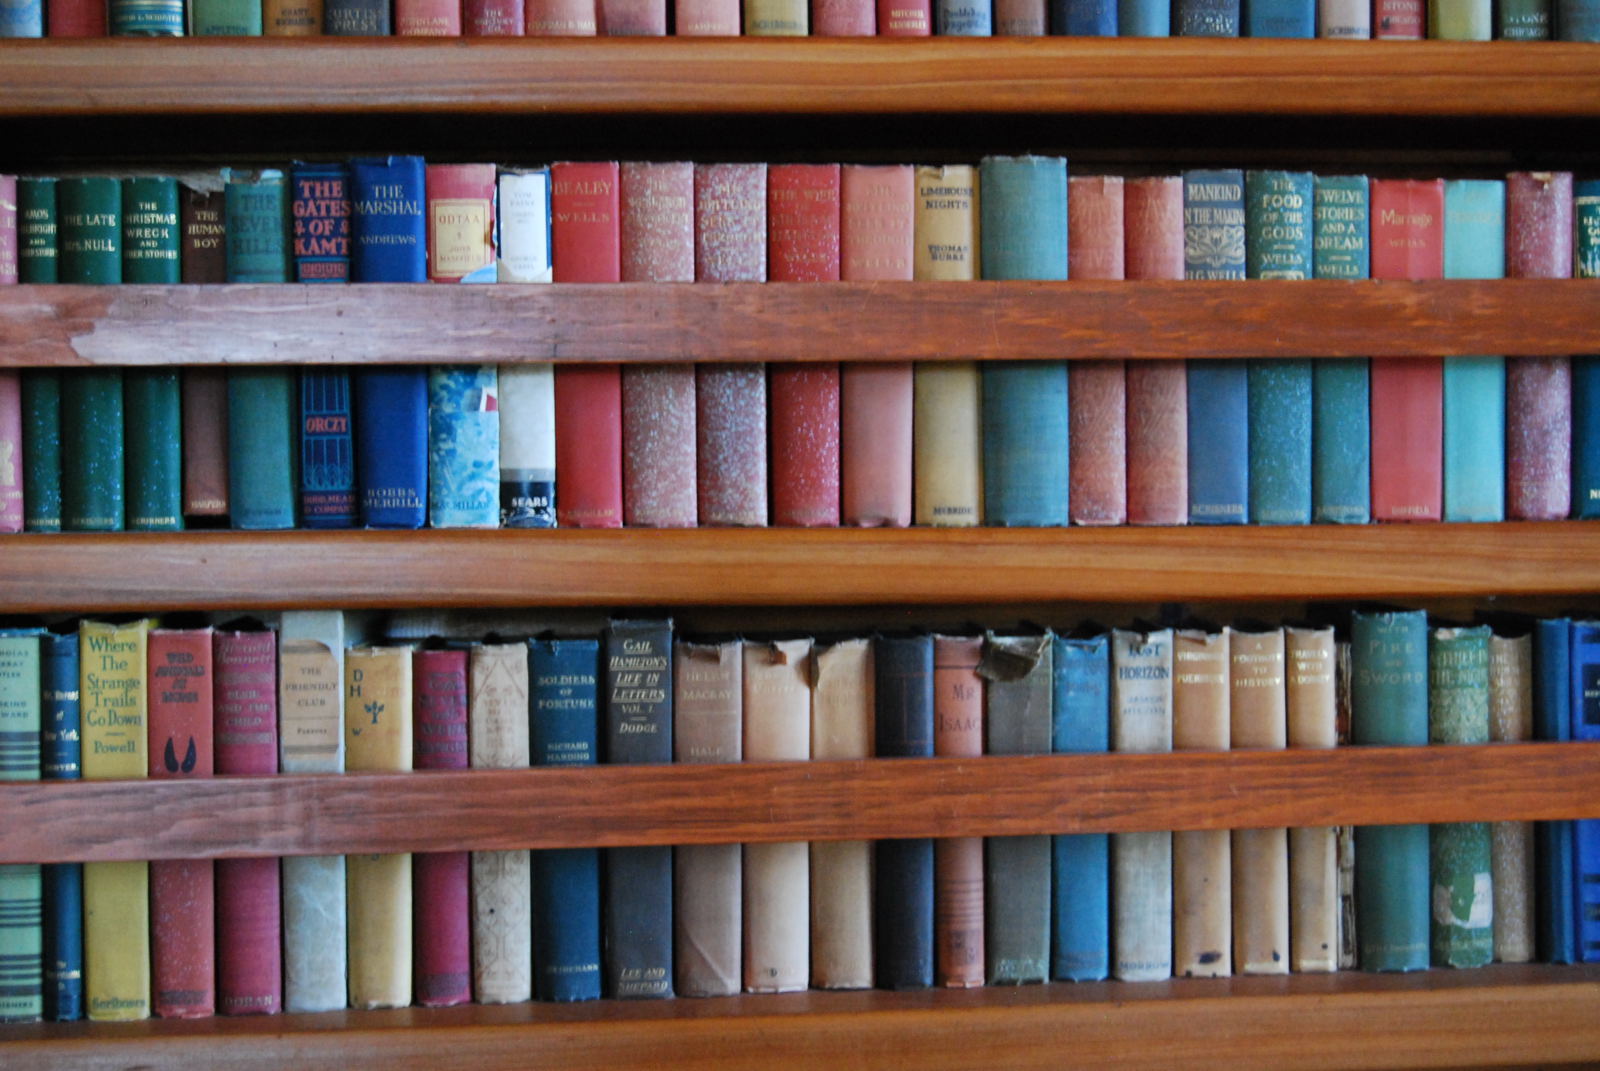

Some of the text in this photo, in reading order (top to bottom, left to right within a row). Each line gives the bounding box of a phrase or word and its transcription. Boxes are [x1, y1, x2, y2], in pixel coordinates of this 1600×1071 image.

[300, 180, 343, 198] THE
[373, 185, 404, 199] THE
[555, 181, 612, 197] BEALBY
[1272, 180, 1295, 191] THE
[920, 187, 974, 198] LIMEHOUSE
[1188, 184, 1241, 201] MANKIND
[1315, 189, 1363, 204] TWELVE
[139, 202, 157, 210] THE
[925, 200, 969, 210] NIGHTS
[1262, 194, 1303, 208] FOOD
[293, 201, 350, 217] GATES
[352, 202, 421, 216] MARSHAL
[1194, 208, 1212, 222] THE
[1314, 206, 1364, 220] STORIES
[86, 214, 116, 227] LATE
[195, 211, 218, 222] THE
[439, 215, 480, 225] ODTAA
[558, 212, 610, 224] WELLS
[1263, 211, 1303, 224] OF THE
[1380, 209, 1433, 227] Marriage
[127, 228, 169, 239] WRECK
[188, 224, 226, 235] HUMAN
[309, 219, 334, 236] OF
[1262, 226, 1304, 240] GODS
[1321, 222, 1356, 234] AND A
[84, 240, 115, 252] NULL
[140, 240, 158, 248] AND
[193, 238, 220, 248] BOY
[360, 234, 417, 245] ANDREWS
[1315, 237, 1363, 250] DREAM
[294, 237, 350, 256] KAMT
[1262, 252, 1303, 264] WELLS
[1317, 263, 1359, 275] WELLS
[305, 416, 347, 433] ORCZY
[512, 496, 548, 508] SEARS
[89, 636, 137, 652] Where
[622, 637, 653, 651] GAIL
[101, 655, 128, 671] The
[610, 655, 668, 668] HAMILTON'S
[300, 667, 321, 676] THE
[353, 669, 364, 683] D
[615, 672, 660, 684] LIFE IN
[1119, 666, 1170, 681] HORIZON
[1360, 670, 1425, 685] SWORD
[87, 673, 141, 691] Strange
[538, 674, 595, 686] SOLDIERS
[285, 683, 337, 692] FRIENDLY
[350, 686, 361, 698] H
[612, 687, 666, 699] LETTERS
[91, 690, 137, 708] Trails
[297, 699, 326, 707] CLUB
[538, 699, 594, 710] FORTUNE
[86, 709, 142, 726] Go Down
[619, 722, 658, 734] DODGE
[94, 740, 136, 753] Powell
[547, 741, 589, 751] RICHARD
[619, 967, 666, 979] LEE AND
